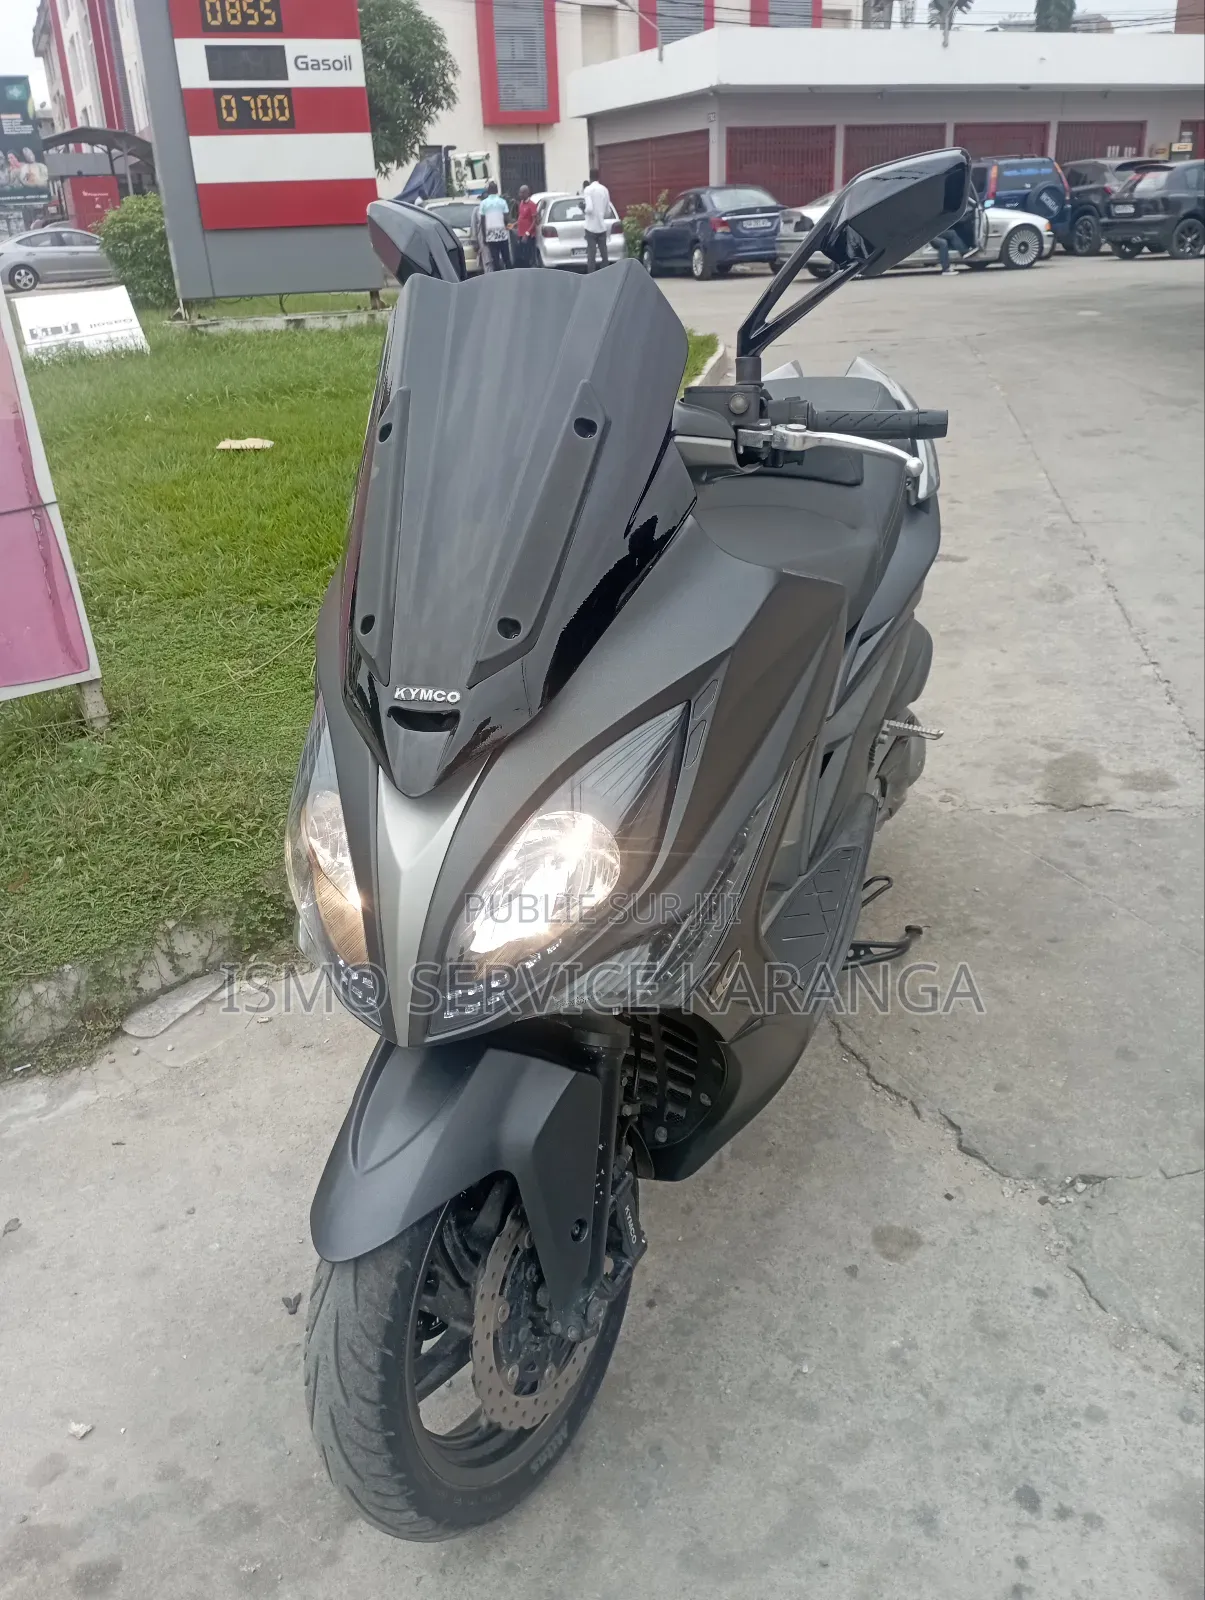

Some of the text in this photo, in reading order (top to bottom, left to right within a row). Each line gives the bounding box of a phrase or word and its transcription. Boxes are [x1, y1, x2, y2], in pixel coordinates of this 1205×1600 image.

[204, 0, 277, 26] 0855
[293, 54, 353, 72] Gasoil
[219, 94, 290, 122] 0700
[394, 686, 461, 704] KYMCO
[624, 1204, 637, 1245] KYMCO
